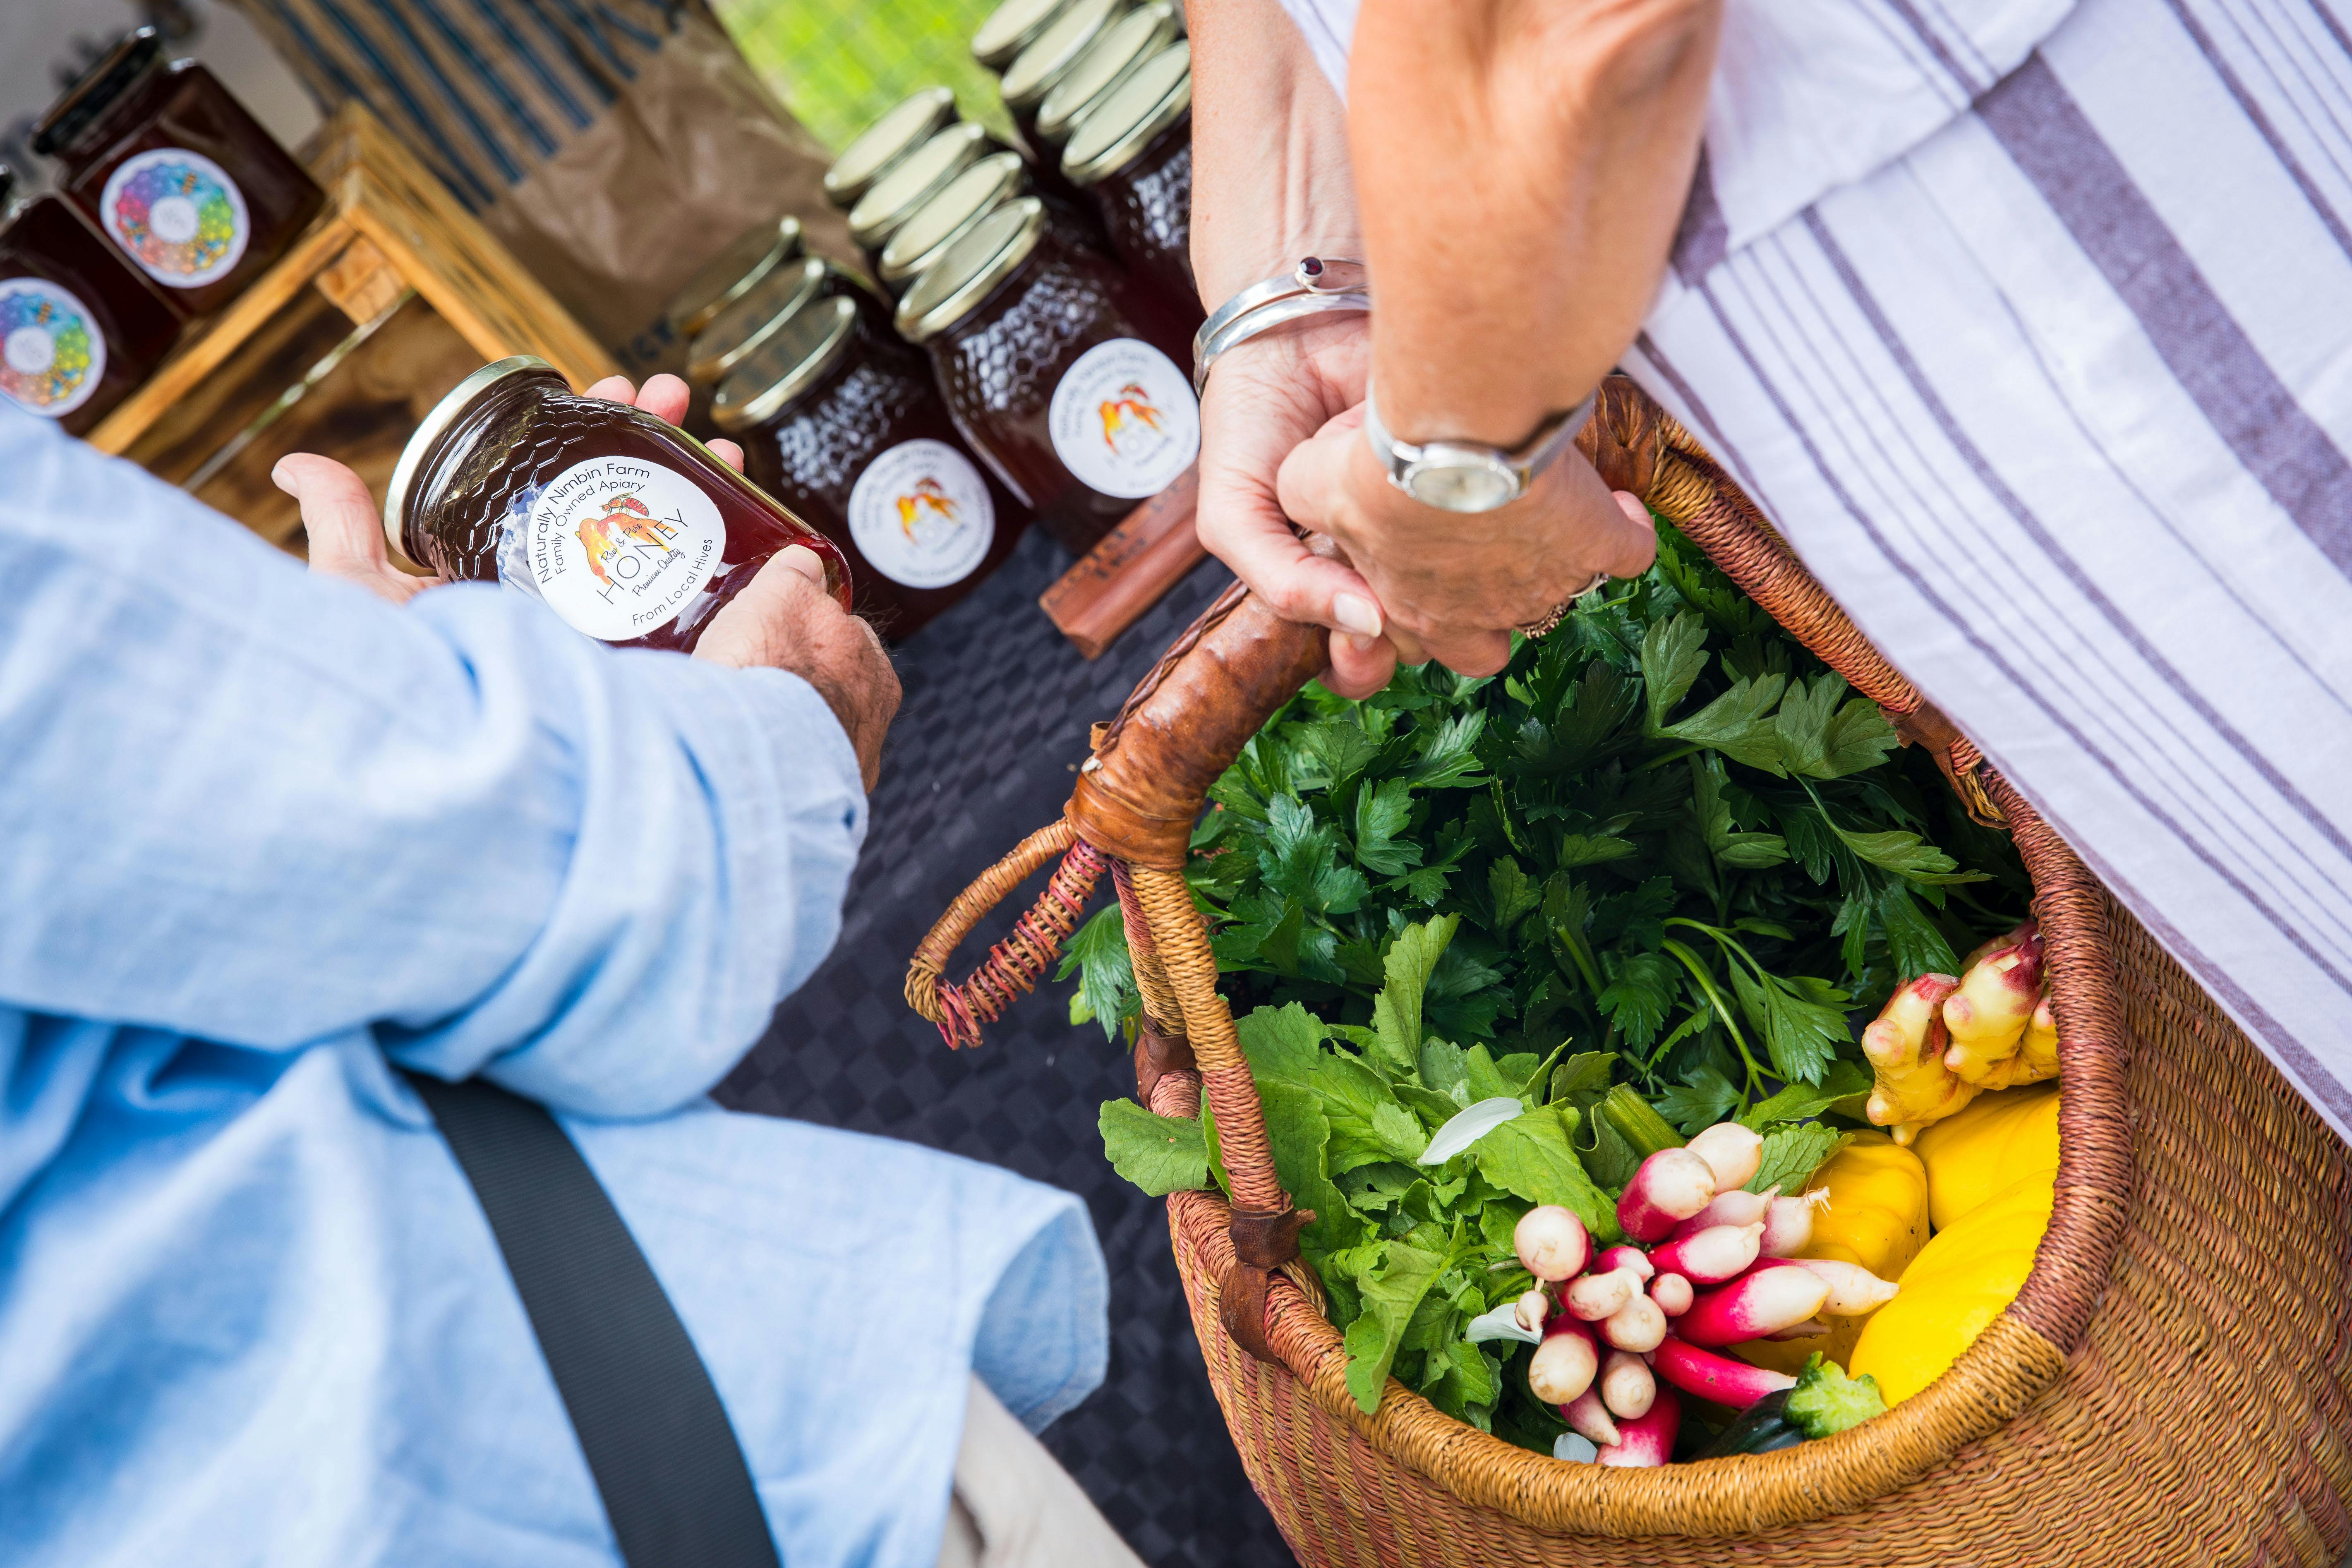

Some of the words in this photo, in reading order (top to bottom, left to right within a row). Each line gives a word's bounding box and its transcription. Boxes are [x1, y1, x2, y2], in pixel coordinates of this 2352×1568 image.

[556, 485, 595, 526] Owned
[599, 479, 645, 492] Apiary
[535, 507, 556, 584] Naturally
[548, 469, 601, 504] Nimbin
[607, 463, 650, 478] Farm
[600, 547, 617, 563] Raw
[616, 538, 626, 547] &
[622, 523, 642, 538] Pure
[551, 532, 566, 574] Family
[597, 508, 688, 604] HONEY
[632, 568, 661, 597] Premium
[657, 548, 685, 570] Quality
[633, 604, 666, 626] From
[665, 571, 698, 605] Local
[692, 539, 712, 570] Hives
